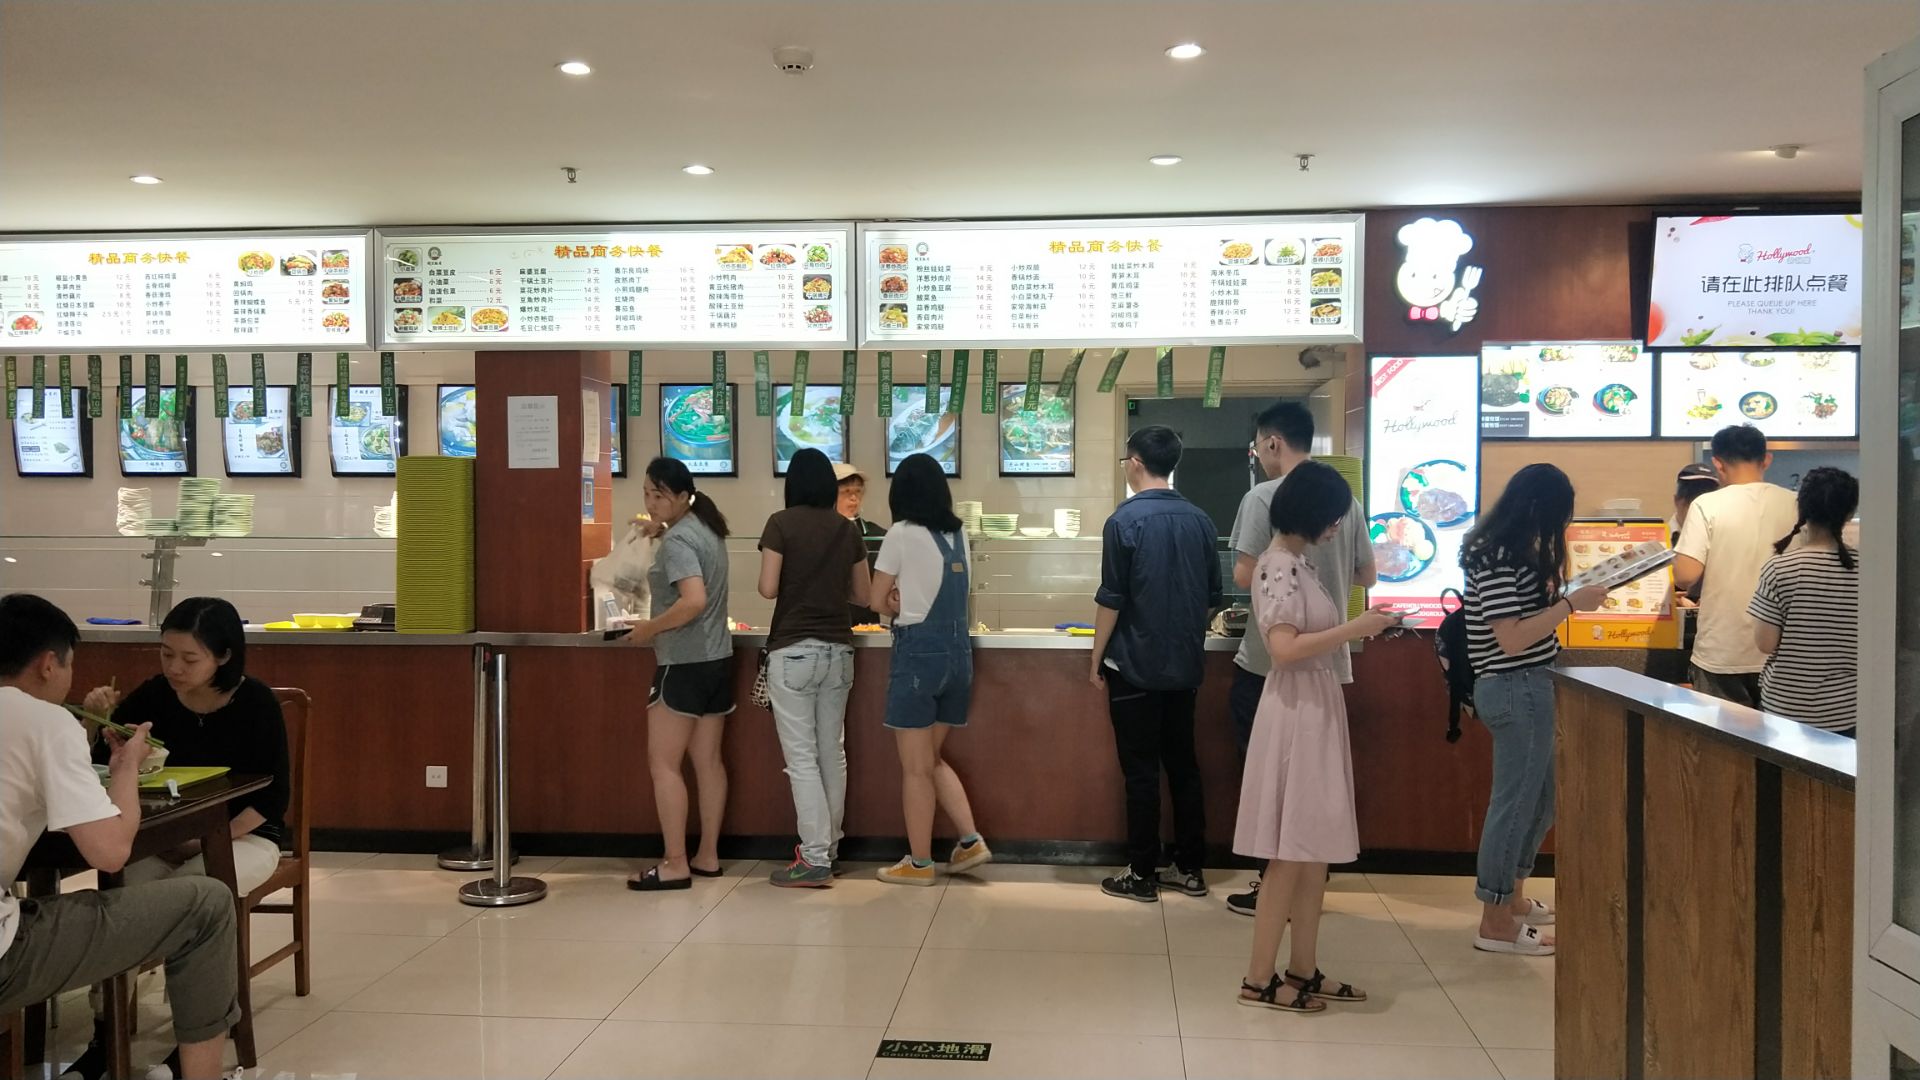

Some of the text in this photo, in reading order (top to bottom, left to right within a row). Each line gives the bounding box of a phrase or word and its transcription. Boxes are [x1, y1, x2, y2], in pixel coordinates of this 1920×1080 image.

[554, 245, 663, 258] 精品商务快餐
[1048, 239, 1163, 254] 精品商务快餐
[88, 252, 190, 265] 精品商务快餐
[1111, 262, 1154, 270] 娃娃菜炒木耳
[1701, 274, 1848, 293] 请在此排队点餐
[880, 355, 891, 416] 酸菜鱼14元
[984, 353, 995, 411] 干锅土豆片8元
[885, 1042, 987, 1055] 小心地滑
